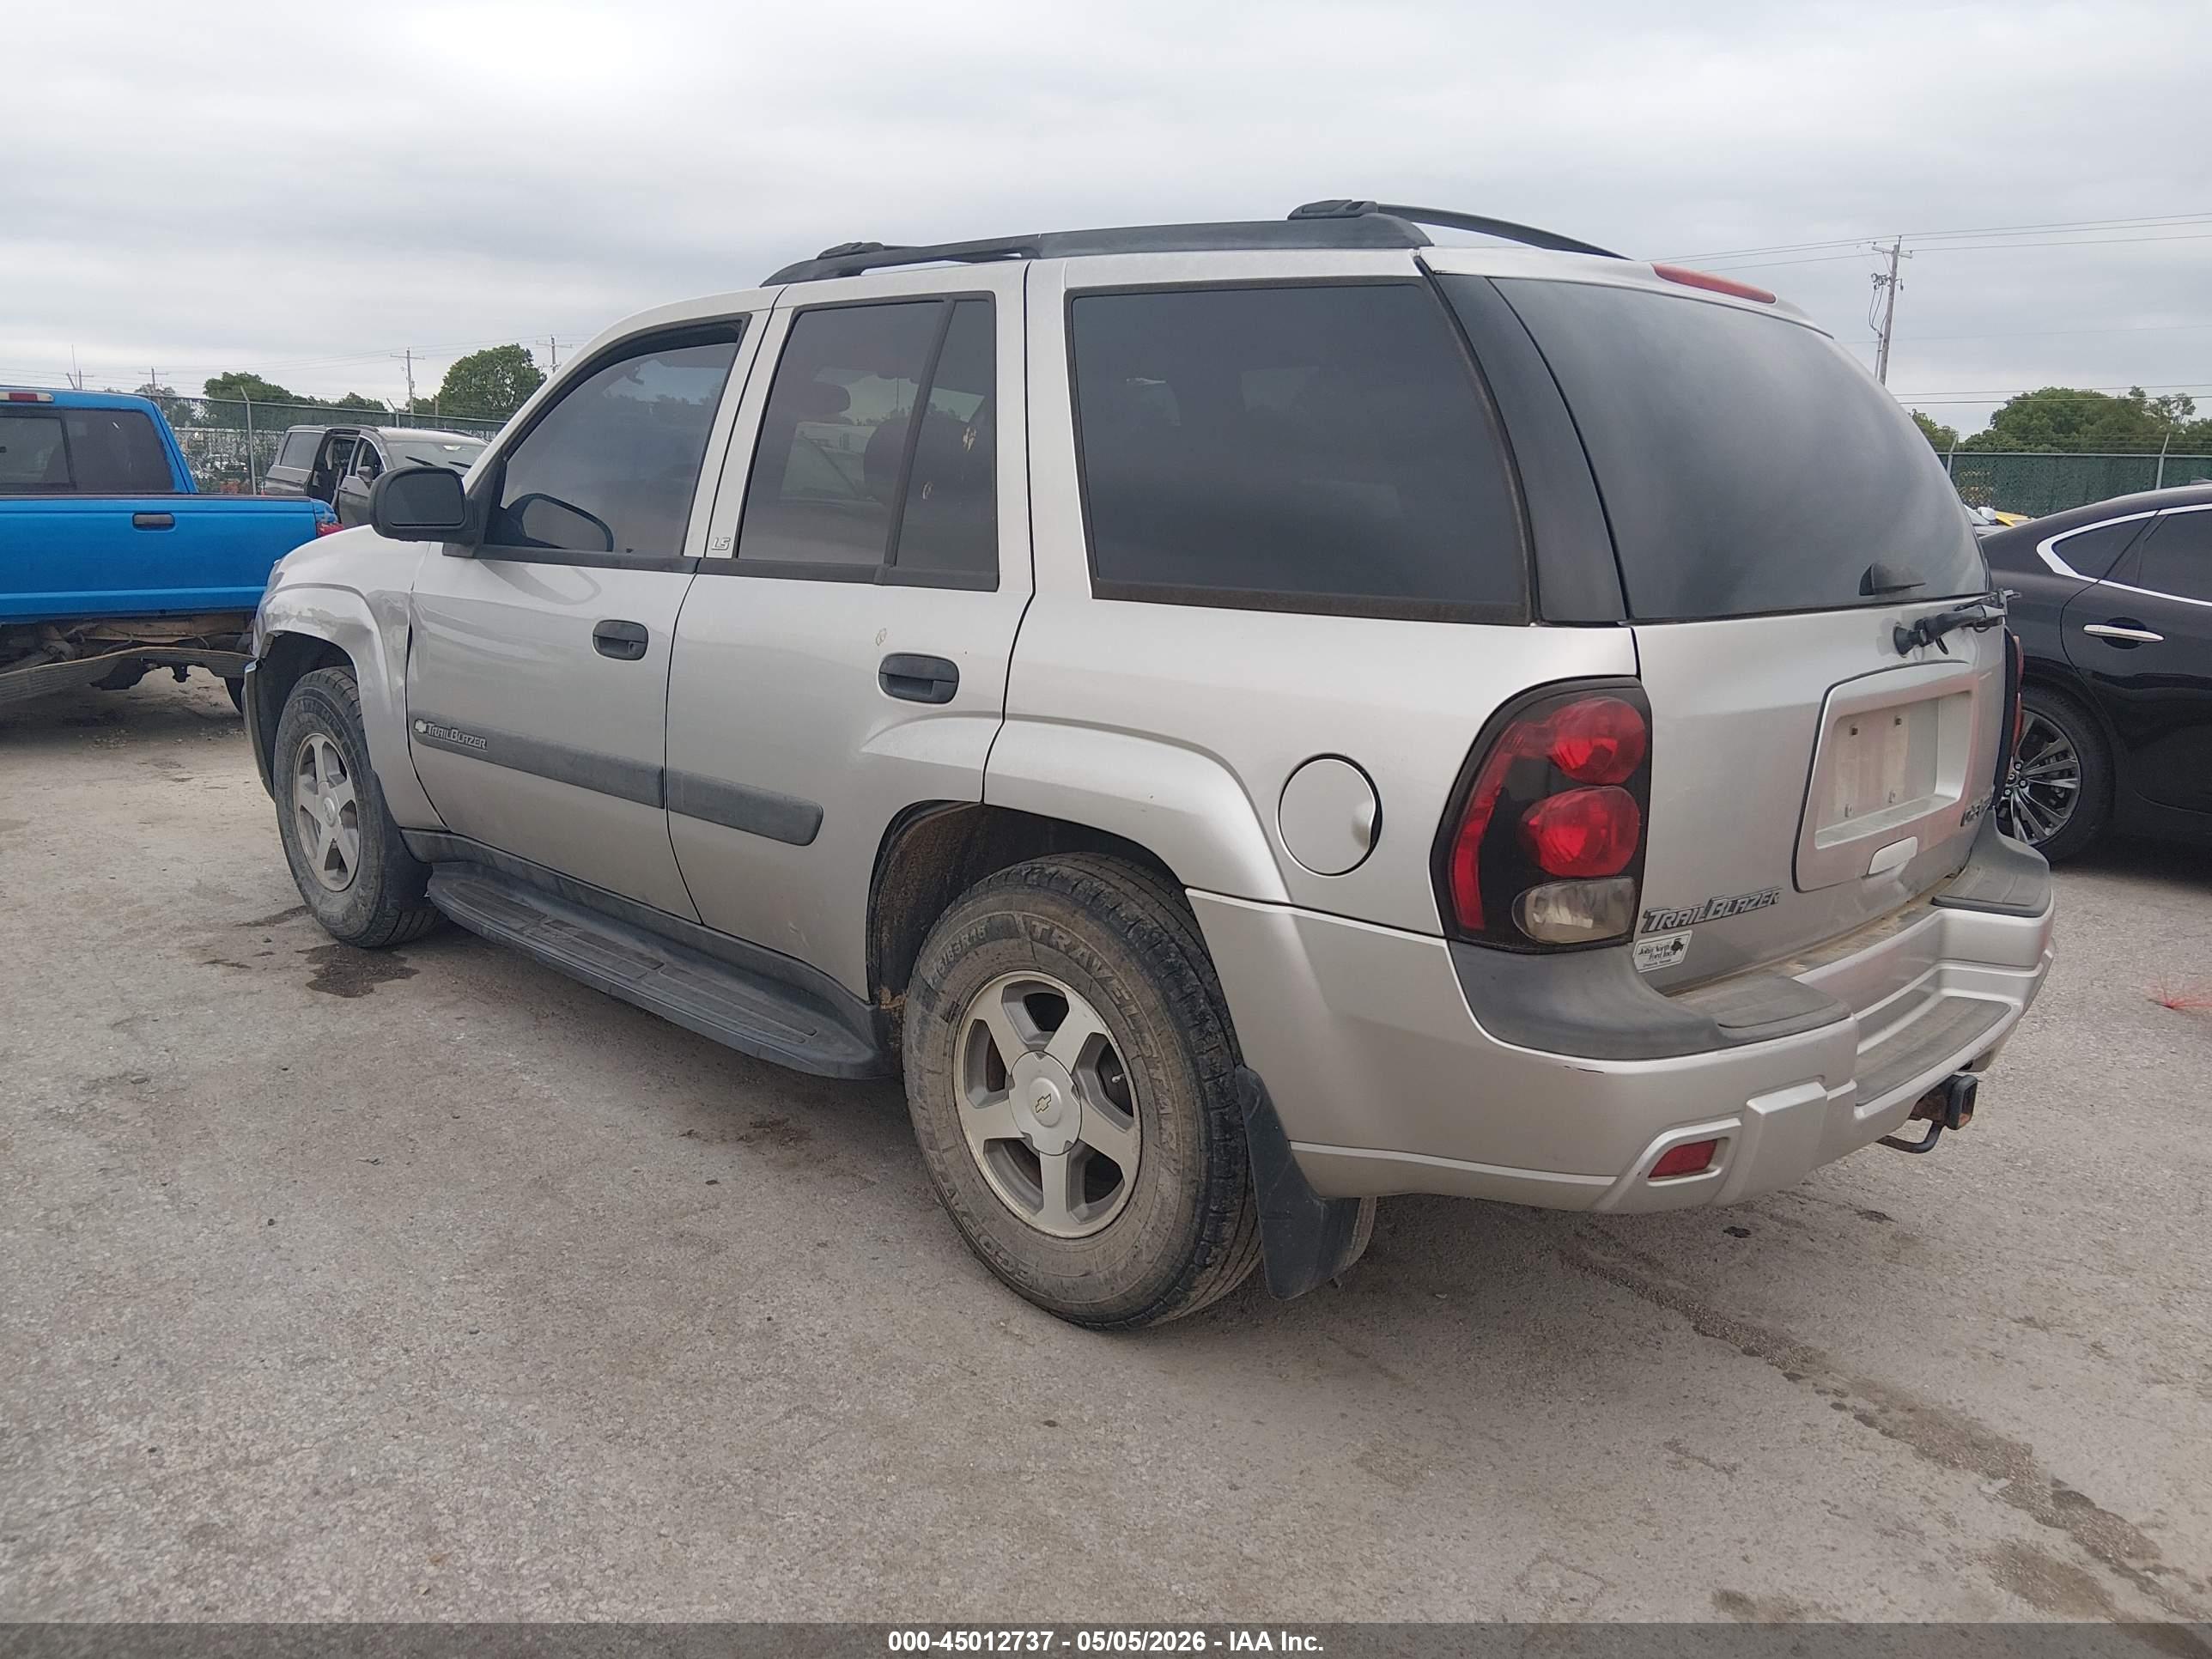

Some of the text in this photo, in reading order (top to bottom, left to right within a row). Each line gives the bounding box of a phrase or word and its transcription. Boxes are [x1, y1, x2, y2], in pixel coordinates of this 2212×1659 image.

[712, 537, 731, 550] LS
[427, 722, 486, 750] TRAILBLAZER
[1642, 890, 1780, 933] TRAILBLAZER
